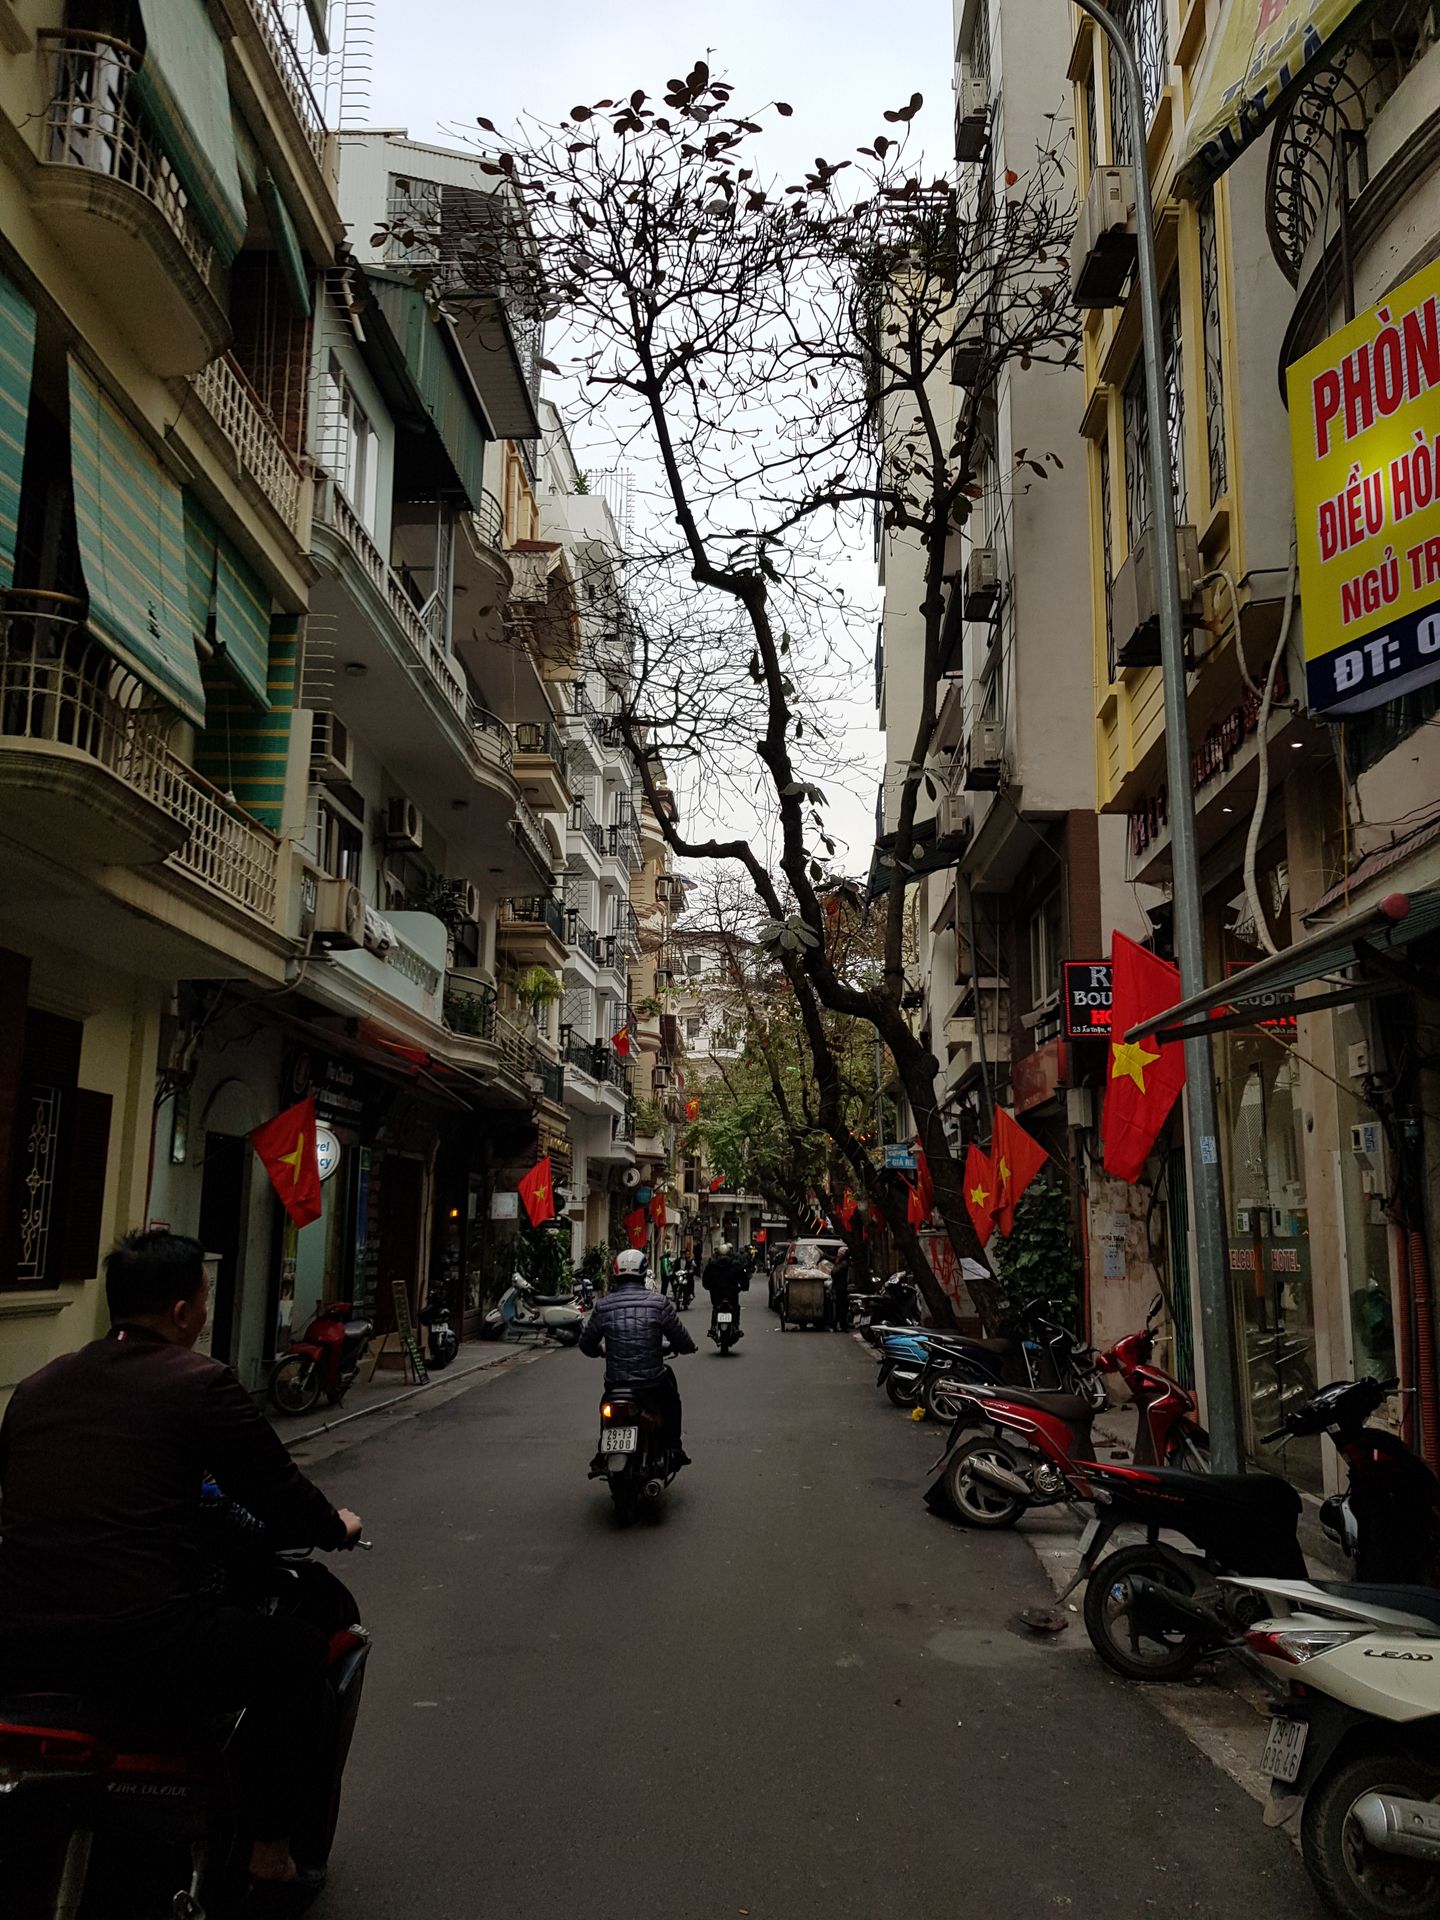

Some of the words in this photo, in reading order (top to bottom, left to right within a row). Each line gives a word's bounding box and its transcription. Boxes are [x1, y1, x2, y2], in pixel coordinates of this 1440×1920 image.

[1312, 296, 1440, 460] PHÒN
[1319, 463, 1384, 562] ĐIỀU
[1390, 430, 1440, 522] HÒ
[1341, 546, 1400, 625] NGỦ
[1333, 635, 1401, 692] ĐT:
[1089, 966, 1112, 987] R
[1271, 1248, 1301, 1272] HOTEL
[1363, 1648, 1434, 1662] LEAD
